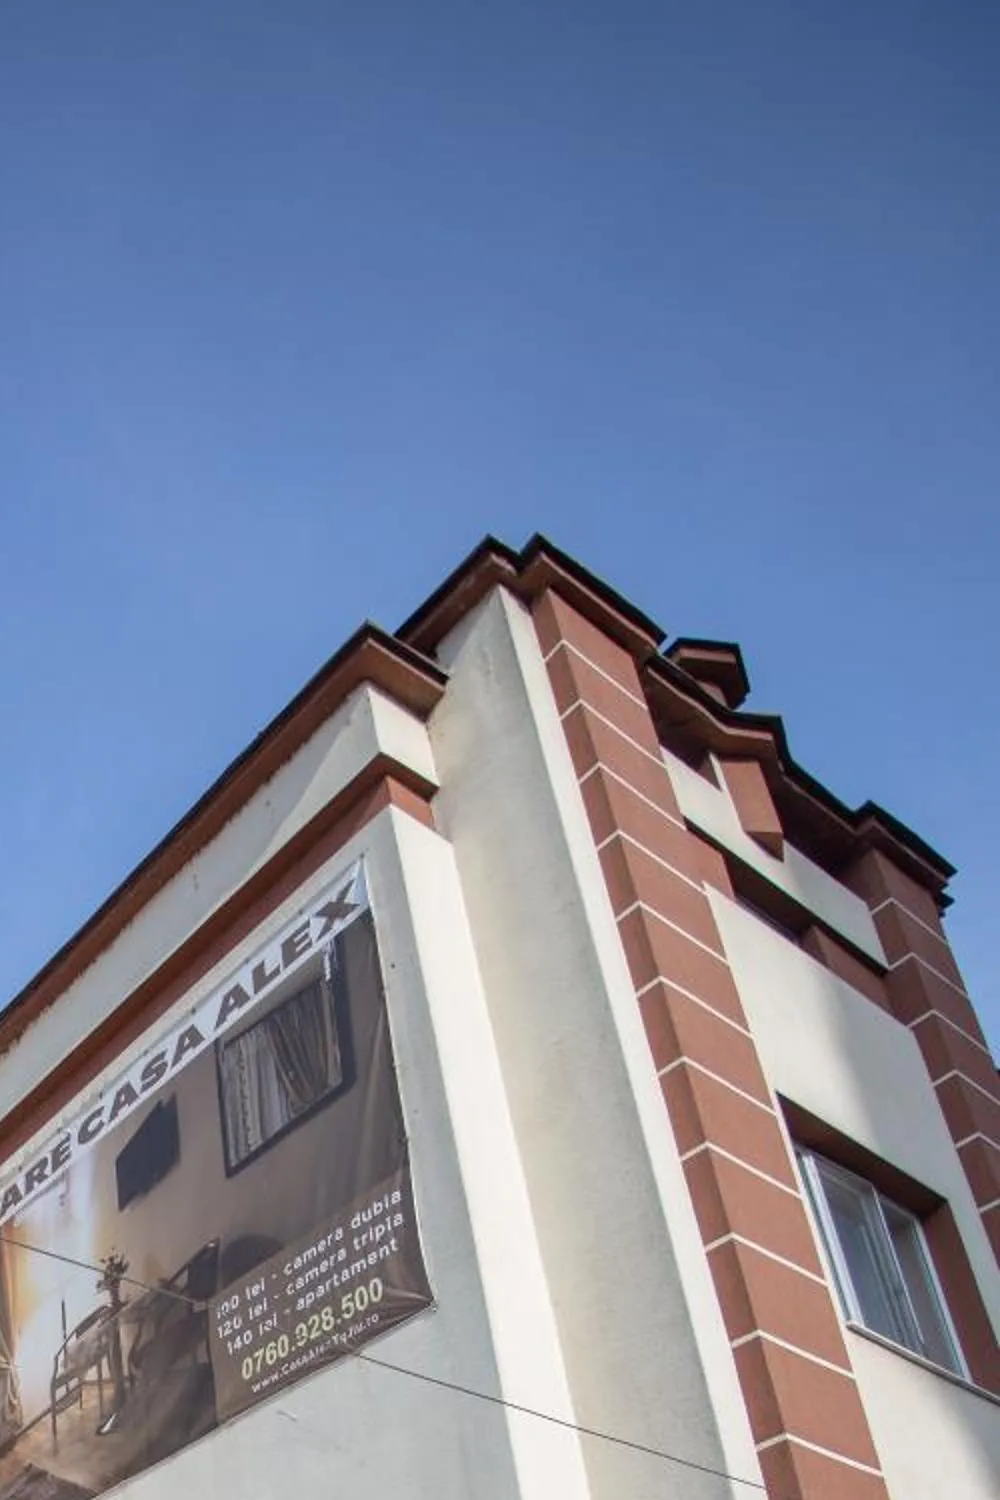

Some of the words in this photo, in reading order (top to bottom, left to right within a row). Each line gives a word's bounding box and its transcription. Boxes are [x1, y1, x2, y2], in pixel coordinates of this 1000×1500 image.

[77, 1023, 205, 1144] CASA
[214, 878, 361, 1031] ALEX
[217, 1316, 242, 1338] 120
[249, 1298, 267, 1319] lei
[286, 1248, 346, 1295] camera
[353, 1213, 404, 1251] tripla
[227, 1332, 252, 1355] 140
[295, 1238, 399, 1311] apartament
[246, 1278, 265, 1300] lei
[283, 1227, 344, 1275] camera
[350, 1190, 402, 1229] dubla
